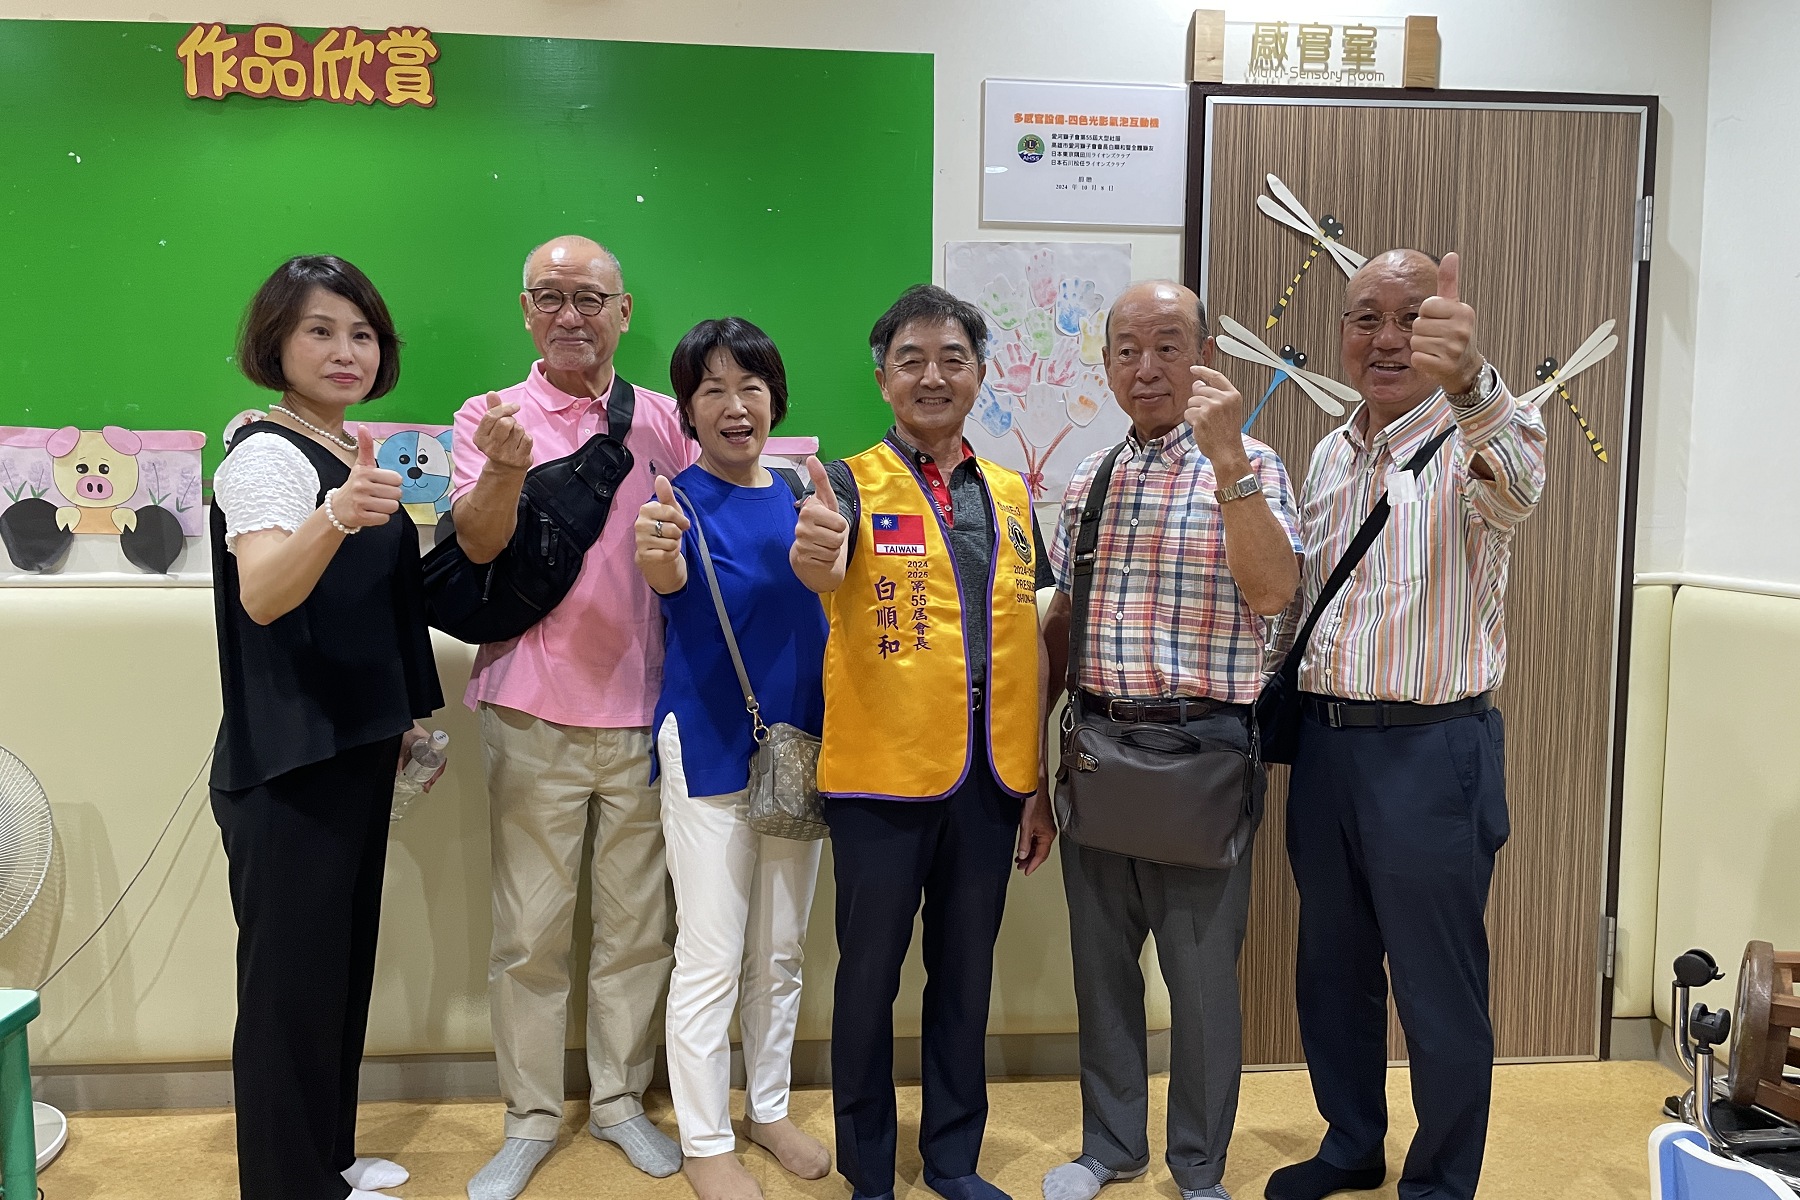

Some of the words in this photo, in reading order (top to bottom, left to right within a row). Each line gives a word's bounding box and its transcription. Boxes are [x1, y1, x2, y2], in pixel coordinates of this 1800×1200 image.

[177, 24, 438, 104] 作品欣賞
[1248, 66, 1342, 82] Multi-Sensory
[1347, 68, 1385, 82] Room
[884, 545, 918, 554] TAIWAN
[907, 560, 929, 568] 2024
[907, 571, 929, 579] 2025
[873, 575, 901, 660] 白順和
